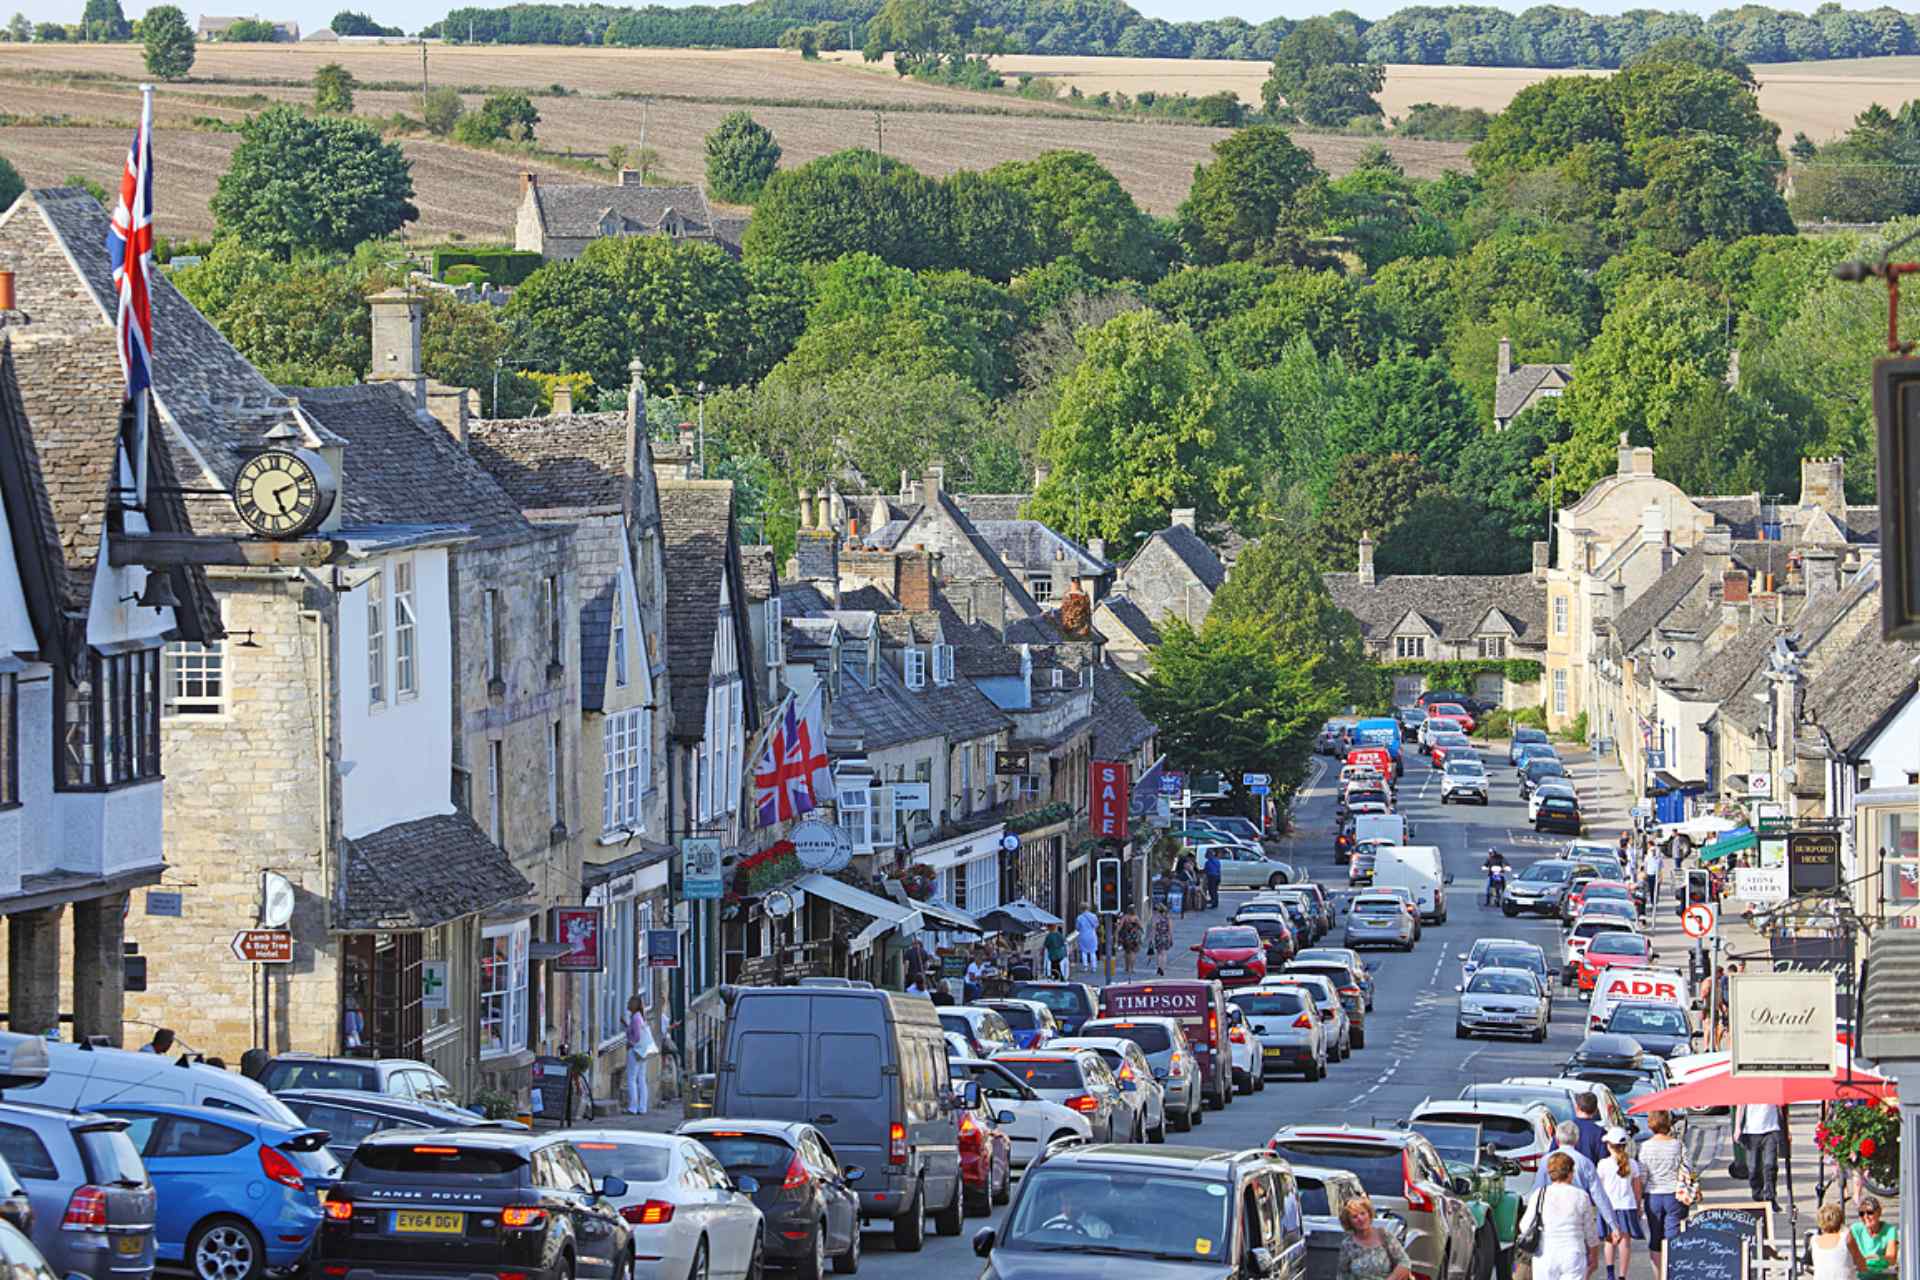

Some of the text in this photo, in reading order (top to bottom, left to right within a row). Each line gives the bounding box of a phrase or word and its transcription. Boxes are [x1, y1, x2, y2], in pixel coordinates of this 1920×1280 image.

[1101, 767, 1117, 834] SALE
[249, 933, 287, 942] Lamb Inn
[254, 942, 270, 952] Bay
[272, 942, 289, 950] Tree
[256, 950, 279, 958] Hotel
[1608, 980, 1677, 998] ADR
[1115, 994, 1197, 1009] TIMPSON
[1750, 1006, 1816, 1026] Detail
[372, 1190, 483, 1200] RANGE ROVER
[399, 1214, 460, 1229] EY64 DGV
